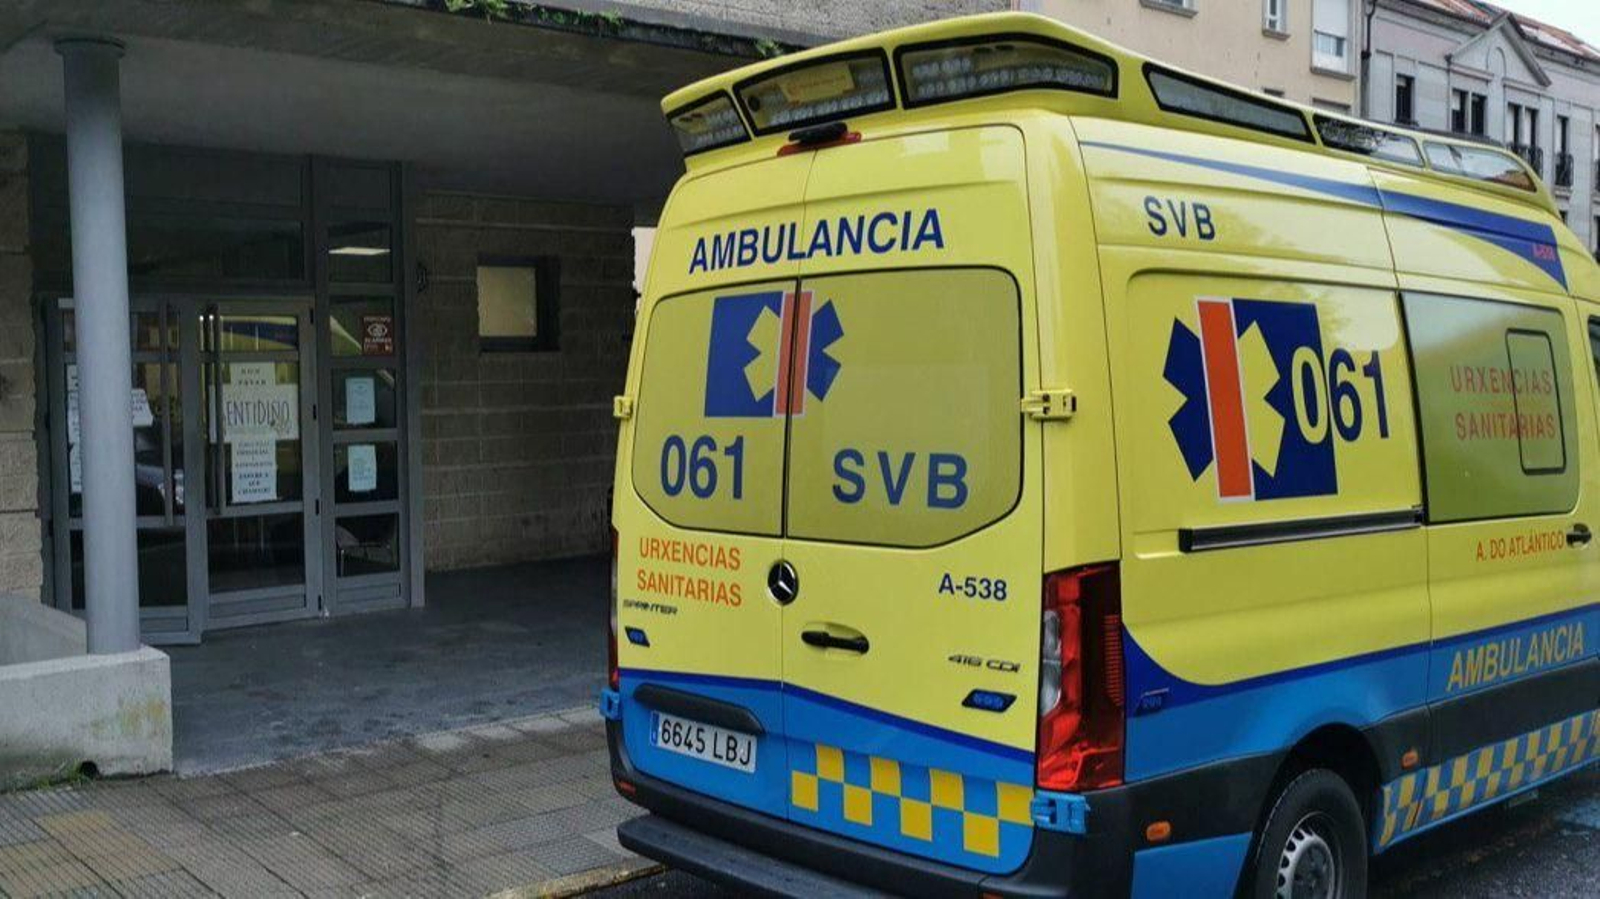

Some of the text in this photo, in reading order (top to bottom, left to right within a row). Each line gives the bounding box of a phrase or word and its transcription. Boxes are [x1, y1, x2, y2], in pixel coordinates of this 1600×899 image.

[1143, 195, 1216, 241] SVB
[689, 208, 945, 275] AMBULANCIA
[1291, 345, 1389, 444] 061
[1450, 365, 1552, 395] URXENCIAS
[1455, 412, 1556, 441] SANITARIAS
[660, 434, 745, 500] 061
[832, 448, 969, 510] SVB
[639, 537, 741, 571] URXENCIAS
[1475, 529, 1564, 562] A. DO ATLÁNTICO
[636, 569, 742, 607] SANITARIAS
[938, 572, 1008, 601] A-538
[948, 655, 1021, 673] 416 CDI
[1446, 621, 1584, 693] AMBULANCIA
[661, 719, 751, 766] 6645 LBJ
